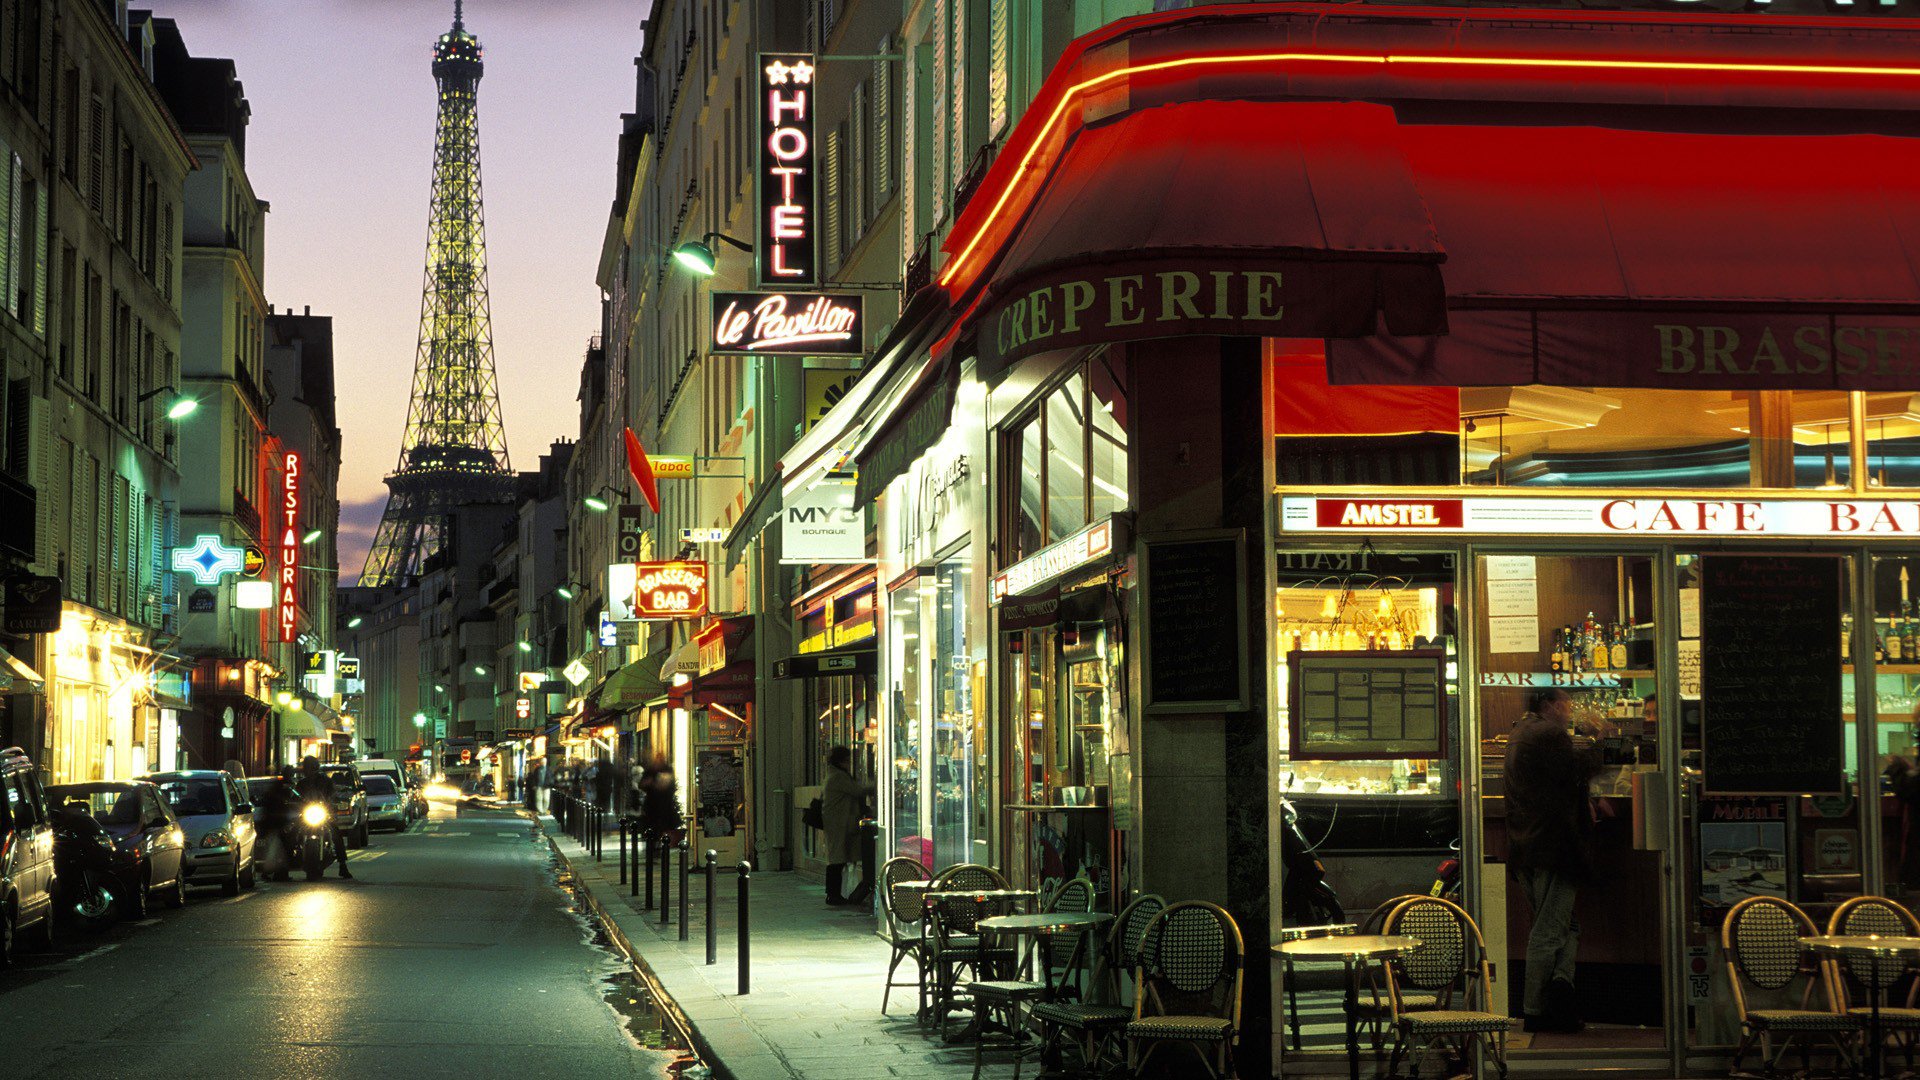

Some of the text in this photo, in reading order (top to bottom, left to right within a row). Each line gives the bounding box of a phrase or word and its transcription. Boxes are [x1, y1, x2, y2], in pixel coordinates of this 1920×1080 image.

[768, 89, 808, 276] HOTEL
[716, 295, 856, 345] Le Pavillon
[996, 270, 1284, 355] CREPERIE
[1653, 324, 1920, 376] BRASSE
[653, 461, 692, 472] Tabac
[1341, 502, 1440, 526] AMSTEL
[1600, 500, 1920, 533] CAFE BA
[281, 453, 298, 641] RESTAURANT
[638, 569, 705, 593] BRASSERIE
[653, 591, 690, 610] BAR
[339, 665, 357, 673] CCF
[1480, 672, 1622, 687] BAR BRAS
[1712, 802, 1786, 820] MOBILE
